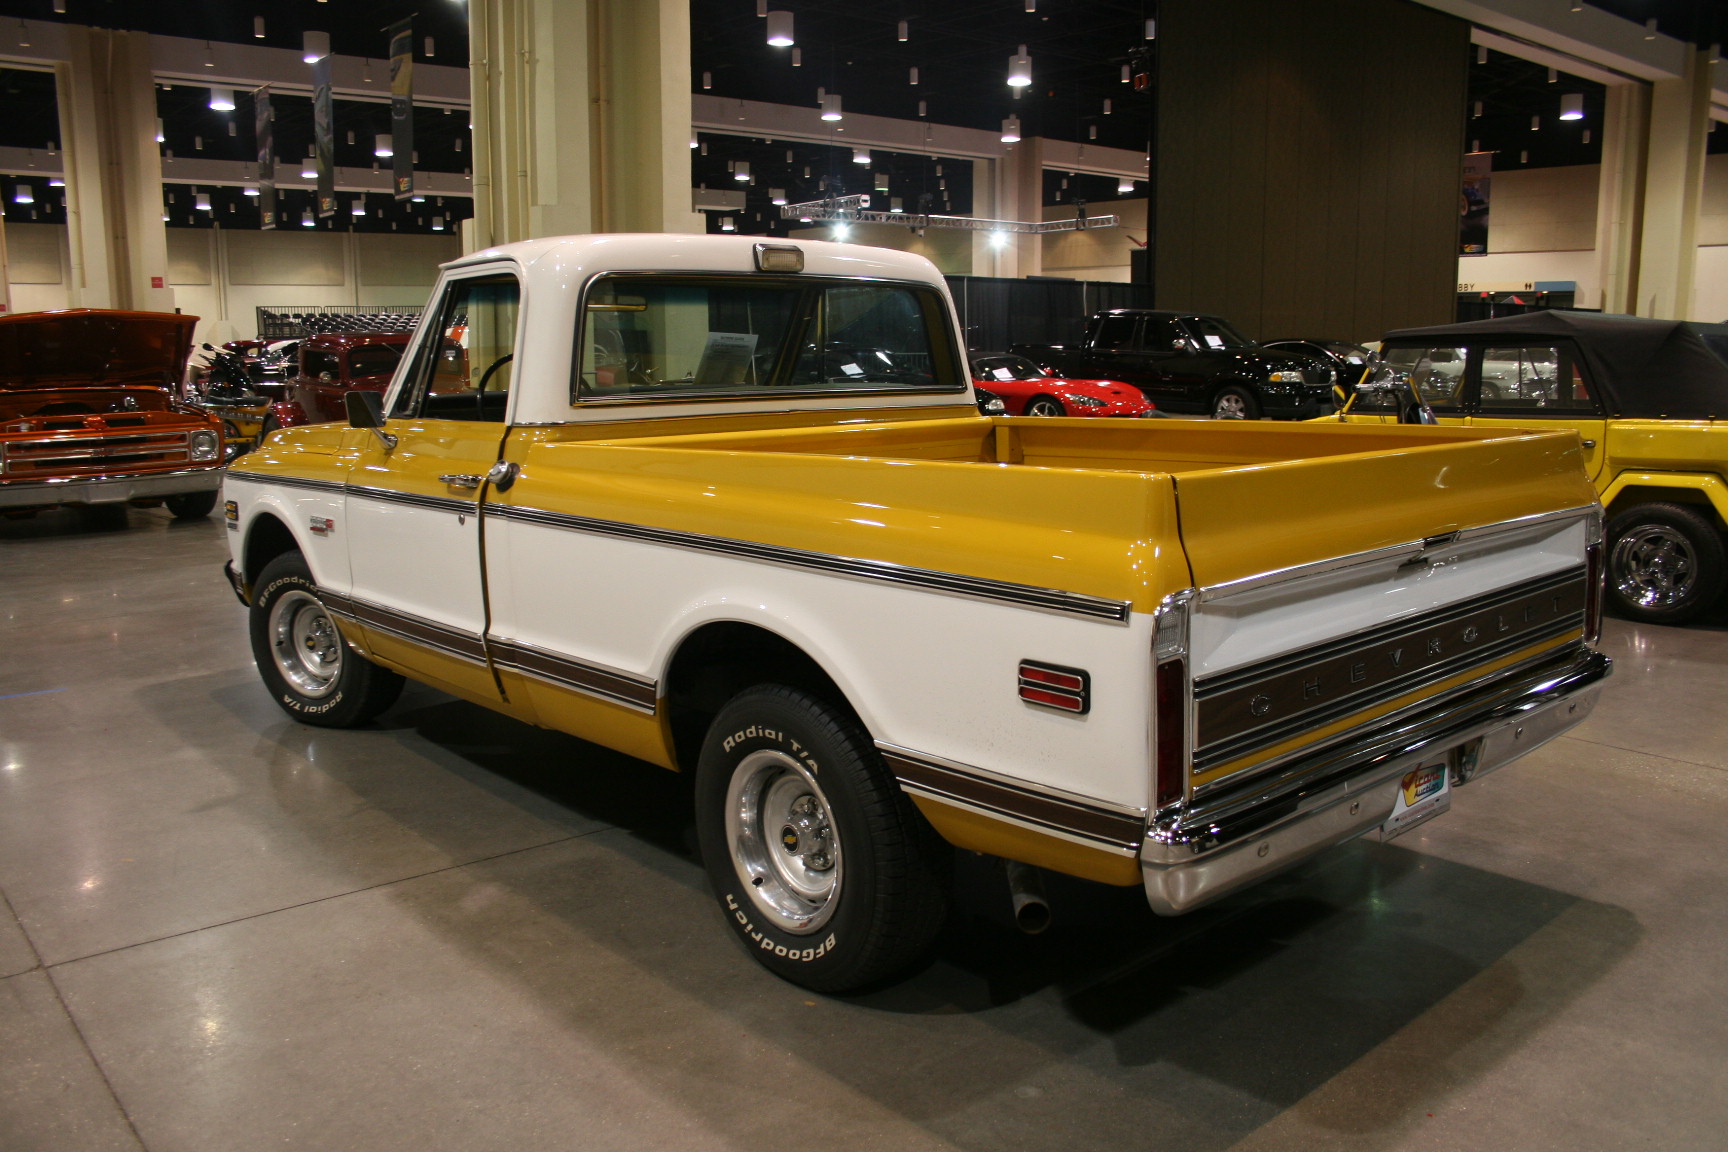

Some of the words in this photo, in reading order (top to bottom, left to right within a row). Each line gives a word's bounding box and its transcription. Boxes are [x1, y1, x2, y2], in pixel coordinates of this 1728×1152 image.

[259, 576, 318, 608] BFGoodric
[1250, 597, 1562, 717] CHEVROLET
[283, 694, 301, 710] T/A
[303, 691, 343, 714] Radial
[723, 725, 783, 753] Radial
[790, 739, 818, 775] T/A
[726, 893, 837, 962] BFGoodrich
